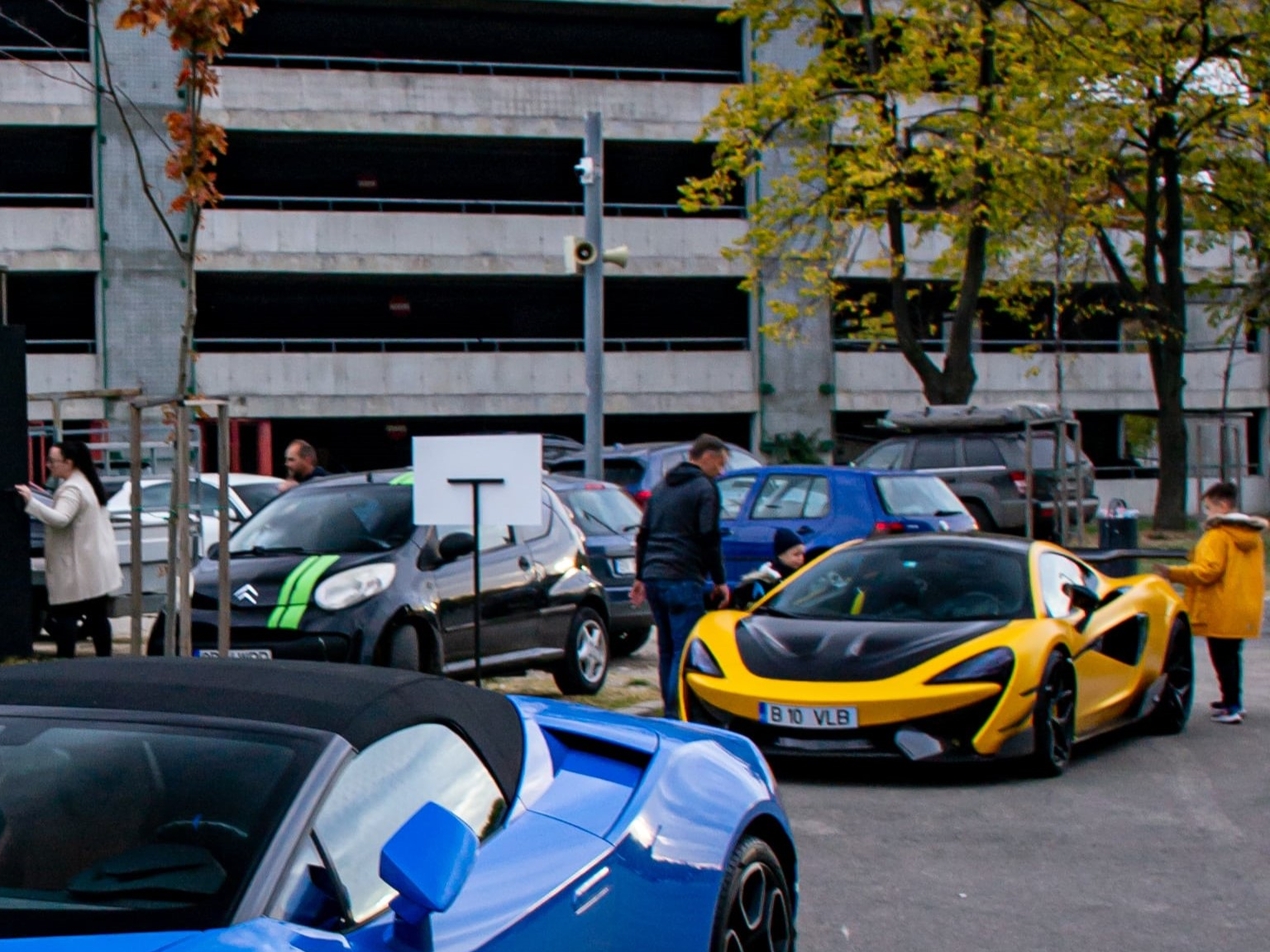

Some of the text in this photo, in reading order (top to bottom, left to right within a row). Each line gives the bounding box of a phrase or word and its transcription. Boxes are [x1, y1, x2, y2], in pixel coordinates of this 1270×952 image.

[771, 705, 850, 726] B 10 VLB
